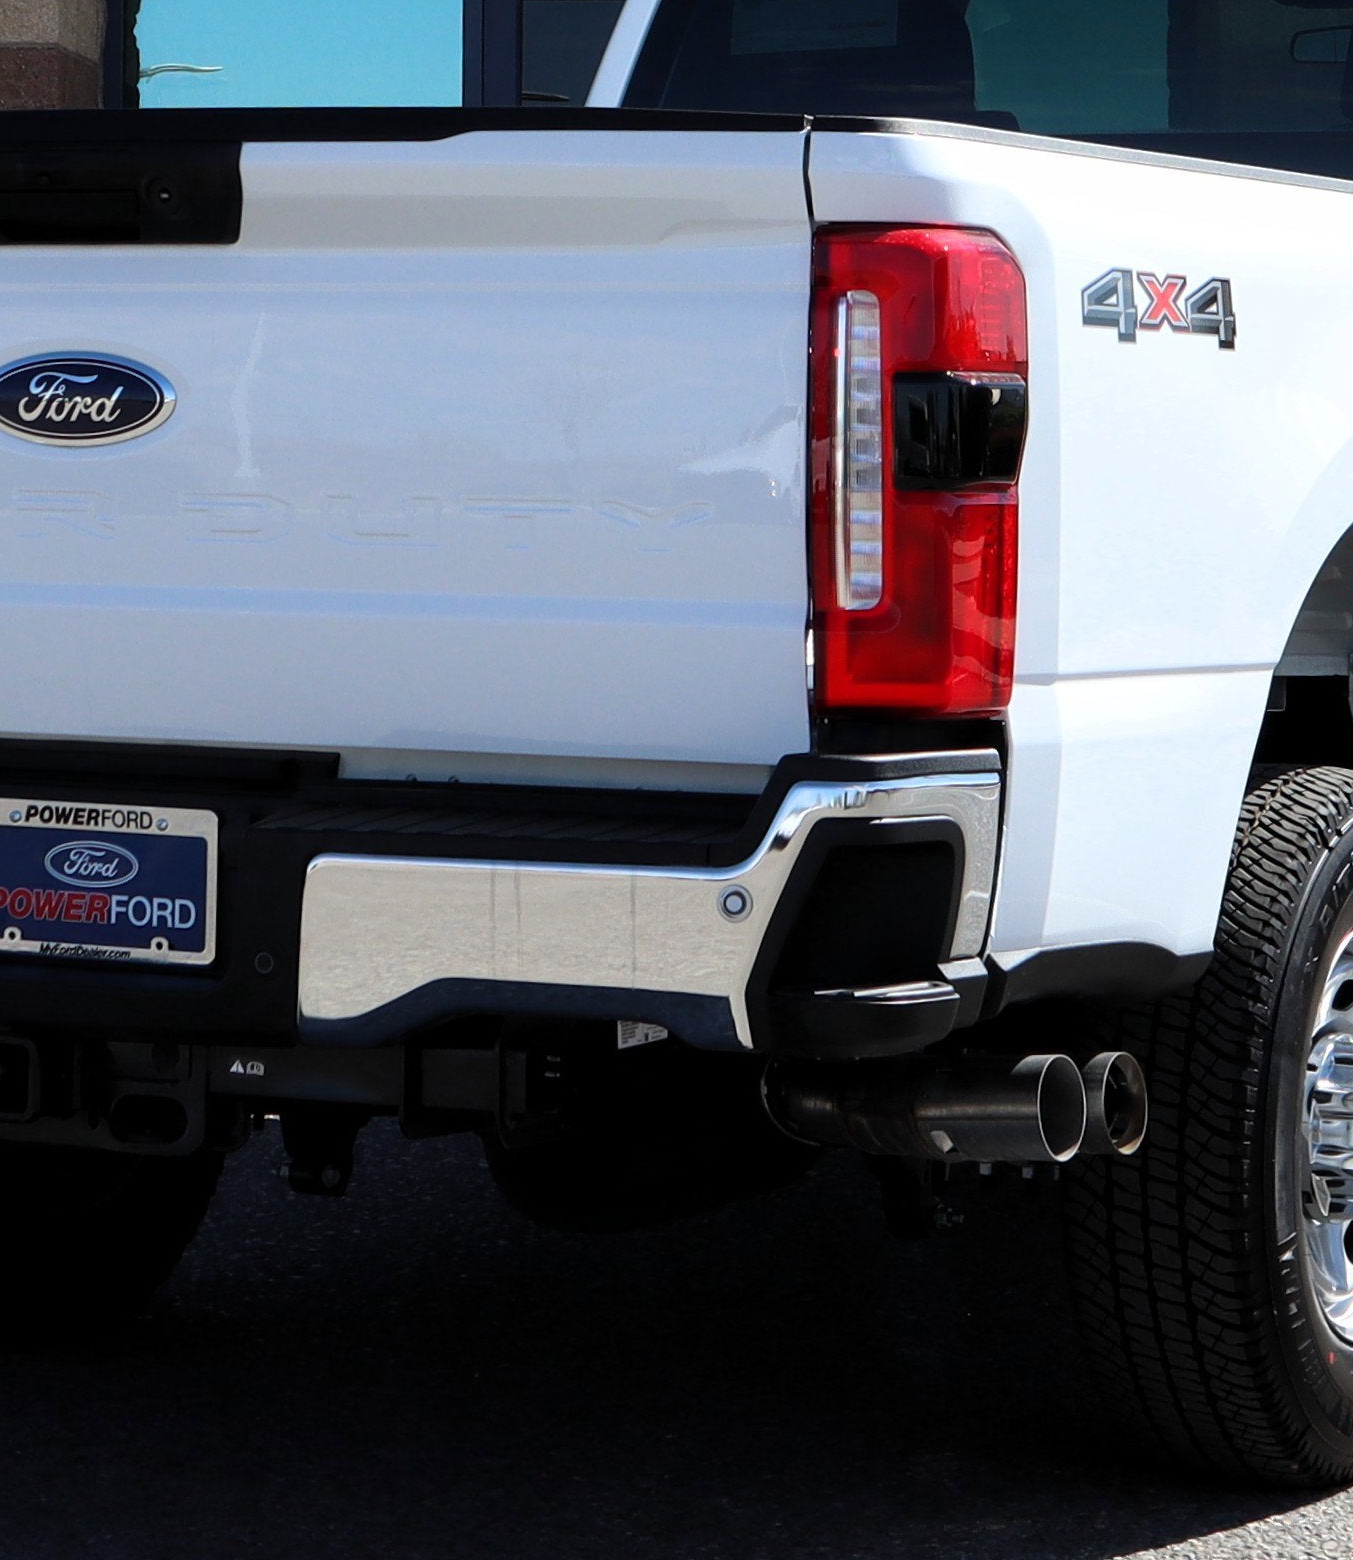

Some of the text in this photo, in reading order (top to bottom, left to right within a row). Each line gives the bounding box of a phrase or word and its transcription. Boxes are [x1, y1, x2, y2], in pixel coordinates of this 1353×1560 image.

[18, 371, 124, 422] Ford
[178, 492, 713, 552] DUTY
[24, 804, 153, 830] POWERFORD
[63, 848, 118, 878] Ford
